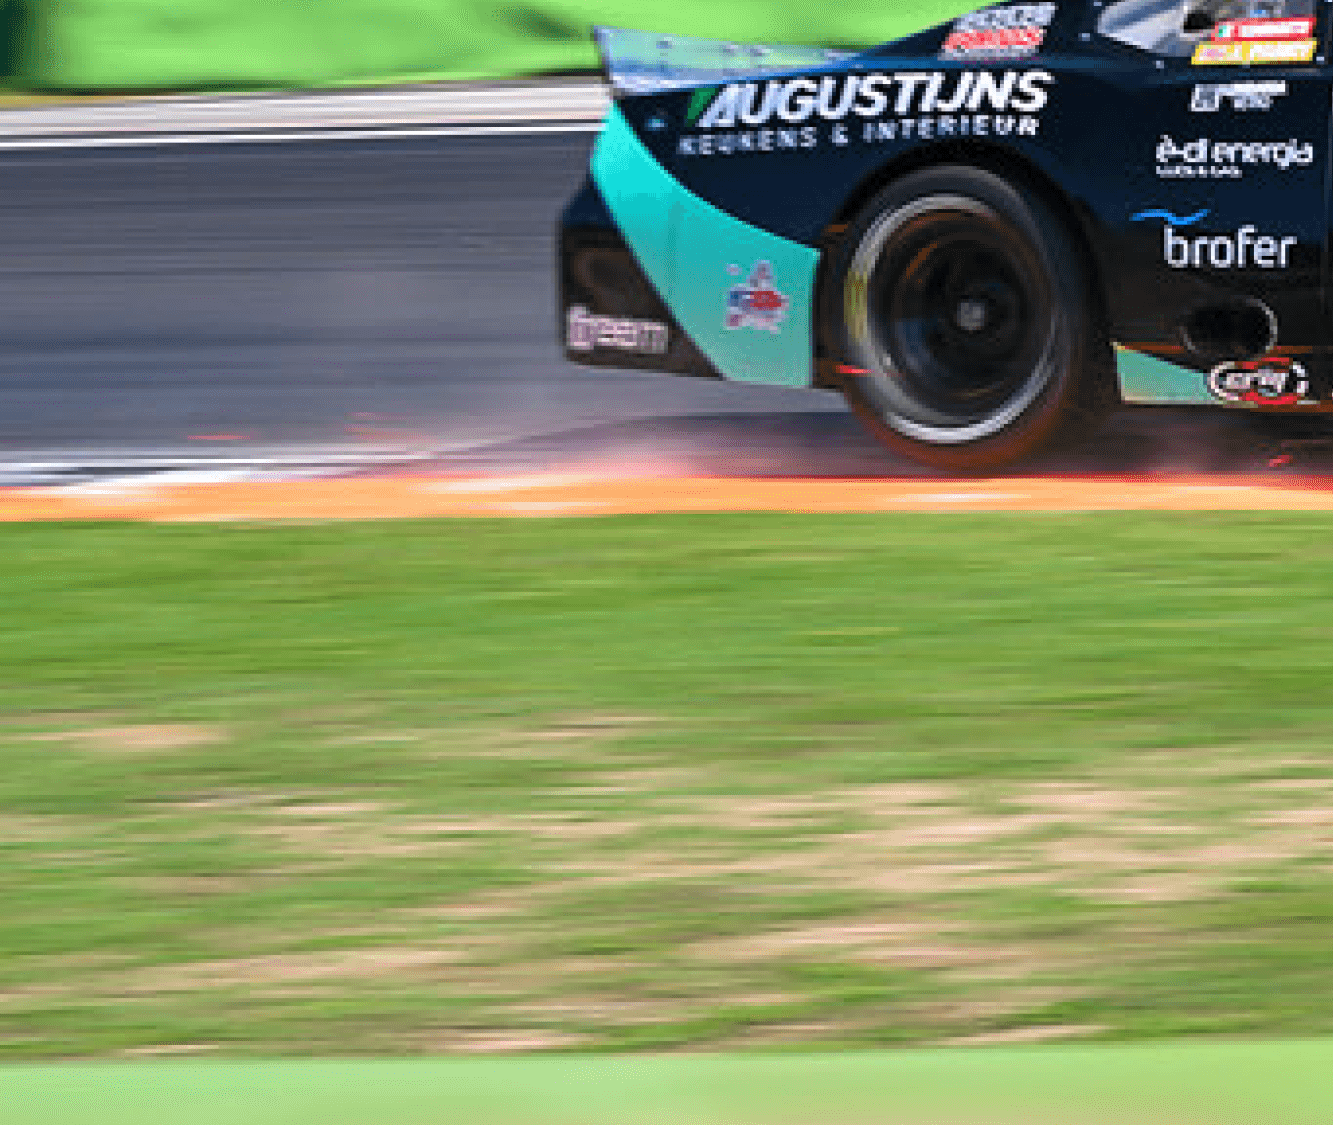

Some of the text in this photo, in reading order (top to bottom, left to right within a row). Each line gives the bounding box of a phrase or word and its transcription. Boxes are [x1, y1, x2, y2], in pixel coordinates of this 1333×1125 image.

[698, 72, 1057, 129] AUGUSTIJNS
[677, 115, 1040, 157] KEUKENS & INTERIEUR
[1211, 137, 1315, 170] energia
[1163, 225, 1298, 268] brofer
